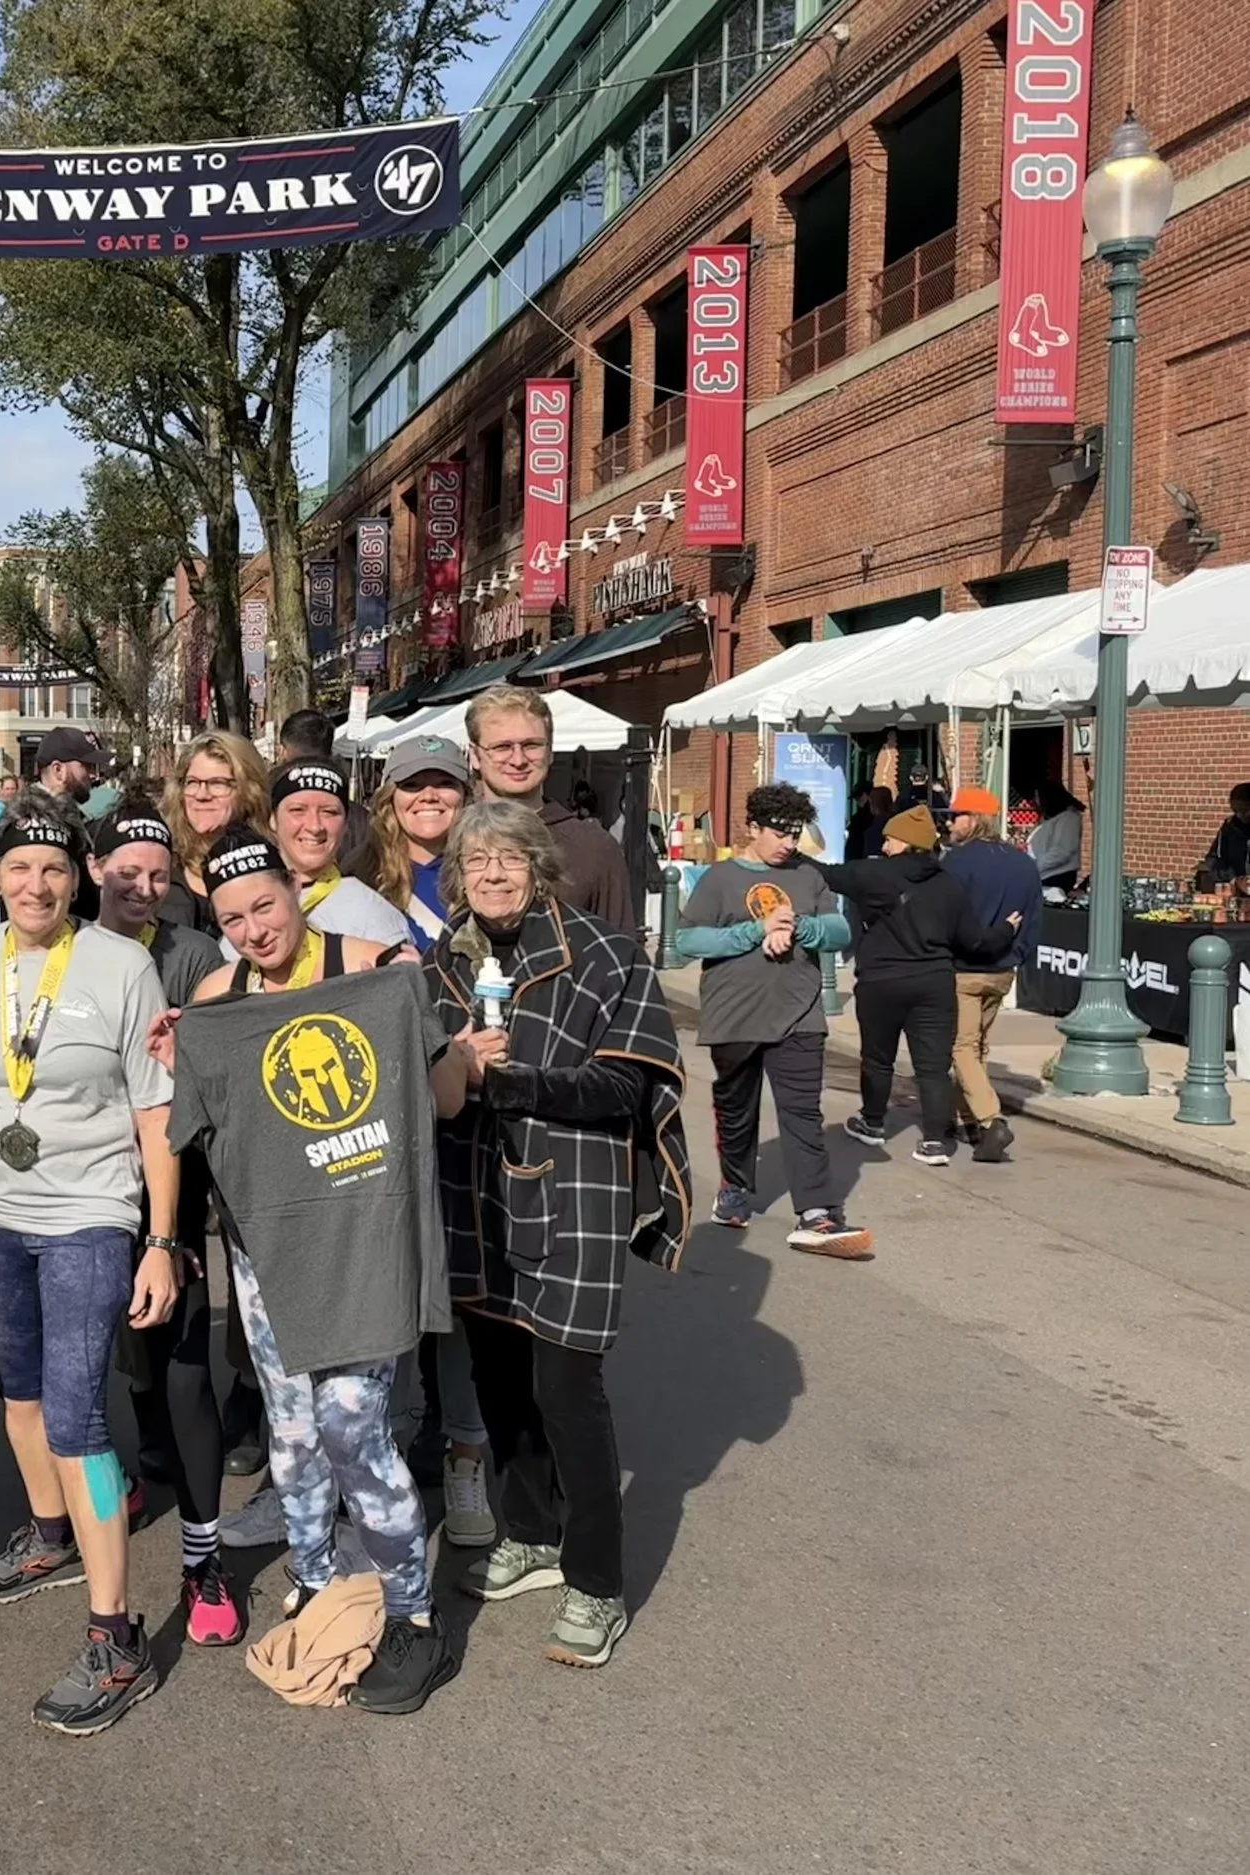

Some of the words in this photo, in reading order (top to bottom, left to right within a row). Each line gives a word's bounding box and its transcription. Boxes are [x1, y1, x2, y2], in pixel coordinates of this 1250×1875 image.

[1015, 0, 1083, 200] 2018
[54, 156, 182, 176] WELCOME
[194, 153, 226, 171] TO
[188, 171, 357, 219] PARK
[96, 235, 162, 253] GATE
[173, 234, 190, 251] D
[694, 255, 740, 393] 2013
[1013, 367, 1056, 380] WORLD
[1013, 381, 1055, 394] SERIES
[999, 395, 1068, 407] CHAMPIONS
[529, 390, 566, 506] 2007
[427, 470, 461, 562] 2004
[358, 524, 385, 597] 1986
[1122, 552, 1147, 564] ZONE
[1116, 568, 1131, 578] NO
[310, 564, 335, 627] 1975
[1114, 590, 1132, 601] ANY
[246, 601, 265, 653] 1946
[298, 777, 338, 793] 11821
[300, 766, 344, 787] SPARTAN
[219, 843, 269, 866] SPARTAN
[218, 856, 268, 879] 11882
[305, 1119, 391, 1168] SPARTAN
[325, 1149, 384, 1175] STADION
